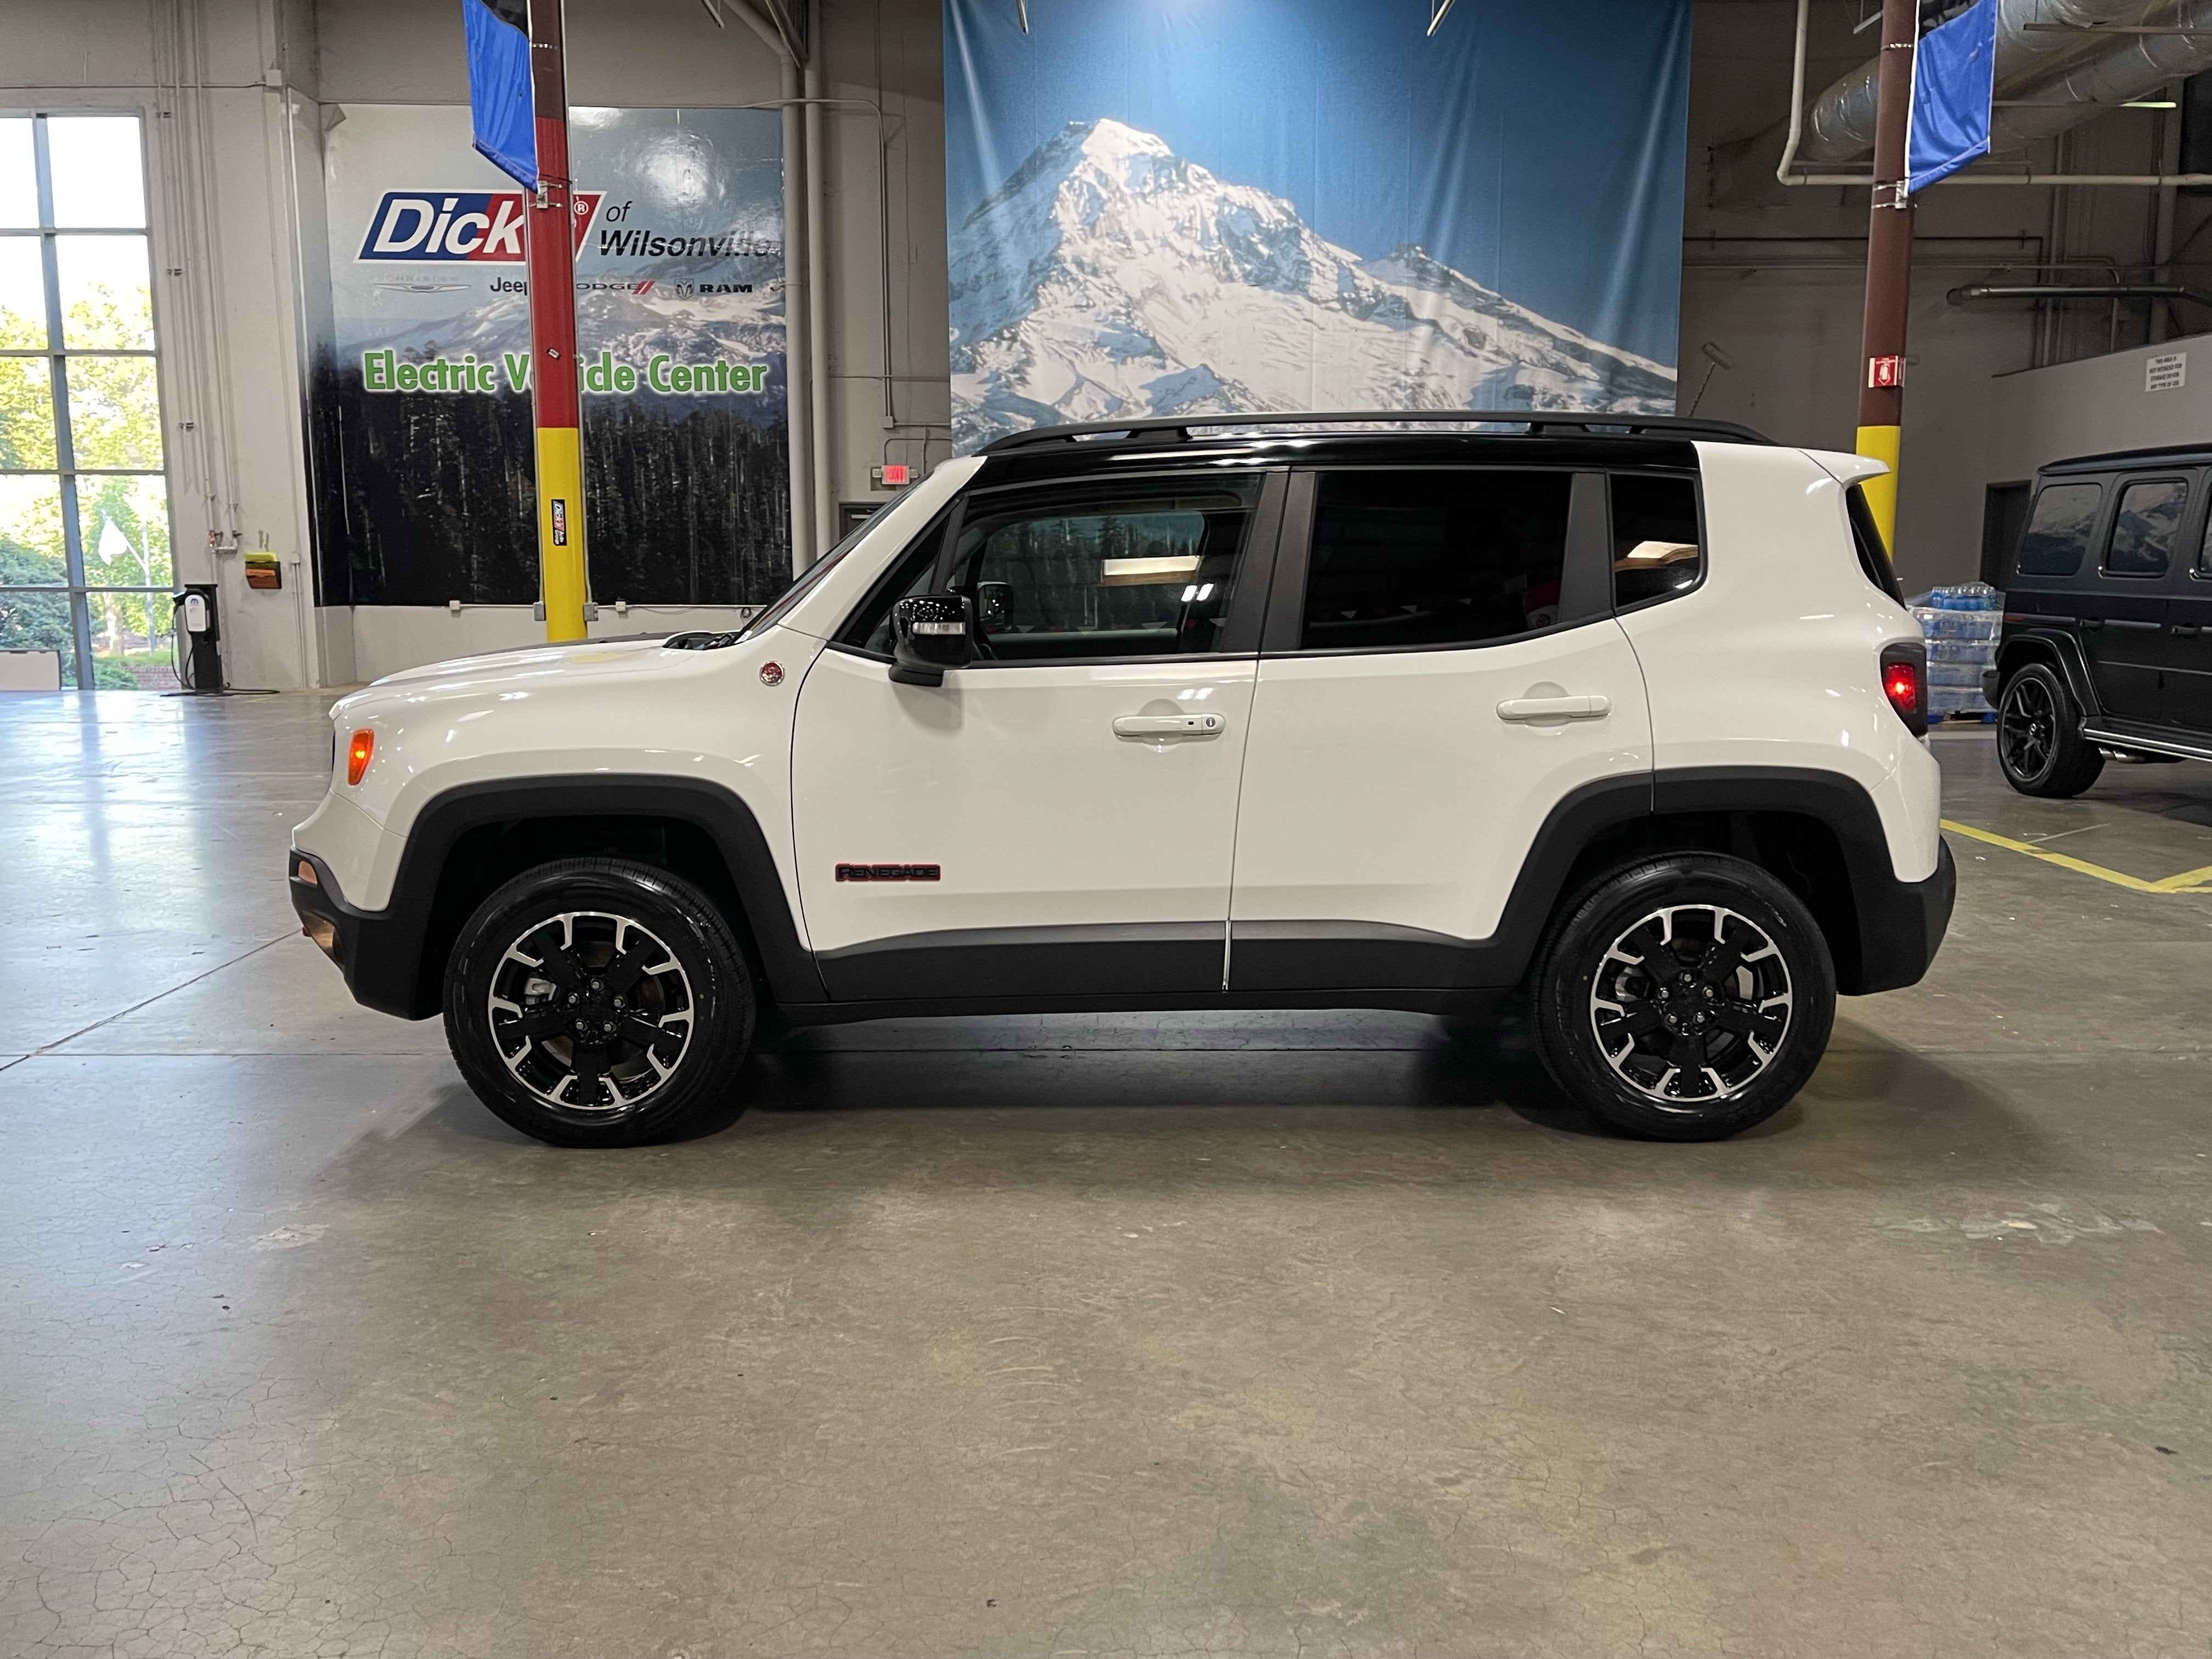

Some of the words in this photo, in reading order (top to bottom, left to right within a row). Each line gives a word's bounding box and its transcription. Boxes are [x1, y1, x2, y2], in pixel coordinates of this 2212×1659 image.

[606, 200, 633, 222] of
[373, 198, 576, 254] Dick
[699, 284, 753, 292] RAM
[364, 349, 494, 391] Electric
[504, 351, 635, 392] Vicle
[649, 355, 768, 392] Center
[888, 466, 906, 482] EXIT
[838, 866, 939, 878] RENEGADE
